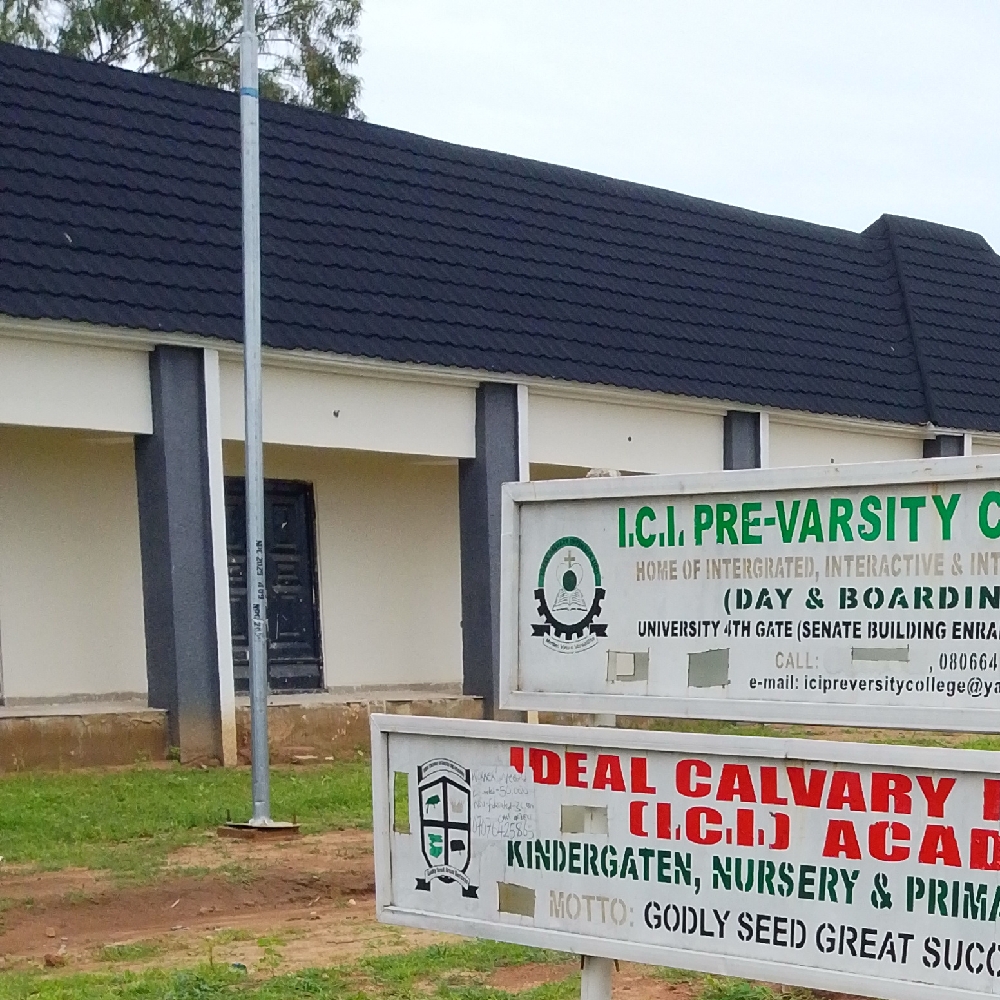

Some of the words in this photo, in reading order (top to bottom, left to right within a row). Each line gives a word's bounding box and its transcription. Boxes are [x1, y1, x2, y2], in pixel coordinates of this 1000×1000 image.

[618, 505, 685, 548] I.C.I.
[694, 493, 961, 546] PRE-VARSITY
[636, 560, 678, 581] HOME
[683, 559, 701, 580] OF
[706, 556, 819, 583] INTERGRATED,
[825, 552, 948, 579] INTERACTIVE
[951, 553, 963, 576] &
[724, 588, 792, 615] (DAY
[805, 587, 824, 609] &
[638, 620, 720, 638] UNIVERSITY
[724, 620, 750, 637] 4TH
[756, 620, 792, 638] GATE
[797, 620, 862, 642] (SENATE
[868, 621, 947, 640] BUILDING
[775, 652, 819, 670] CALL:
[749, 675, 799, 691] e-mail:
[509, 747, 656, 795] IDEAL
[676, 757, 957, 818] CALVARY
[507, 840, 702, 895] KINDERGATEN,
[712, 856, 860, 904] NURSERY
[871, 872, 892, 910] &
[550, 891, 634, 927] MOTTO:
[644, 901, 731, 939] GODLY
[737, 912, 806, 949] SEED
[815, 923, 914, 964] GREAT
